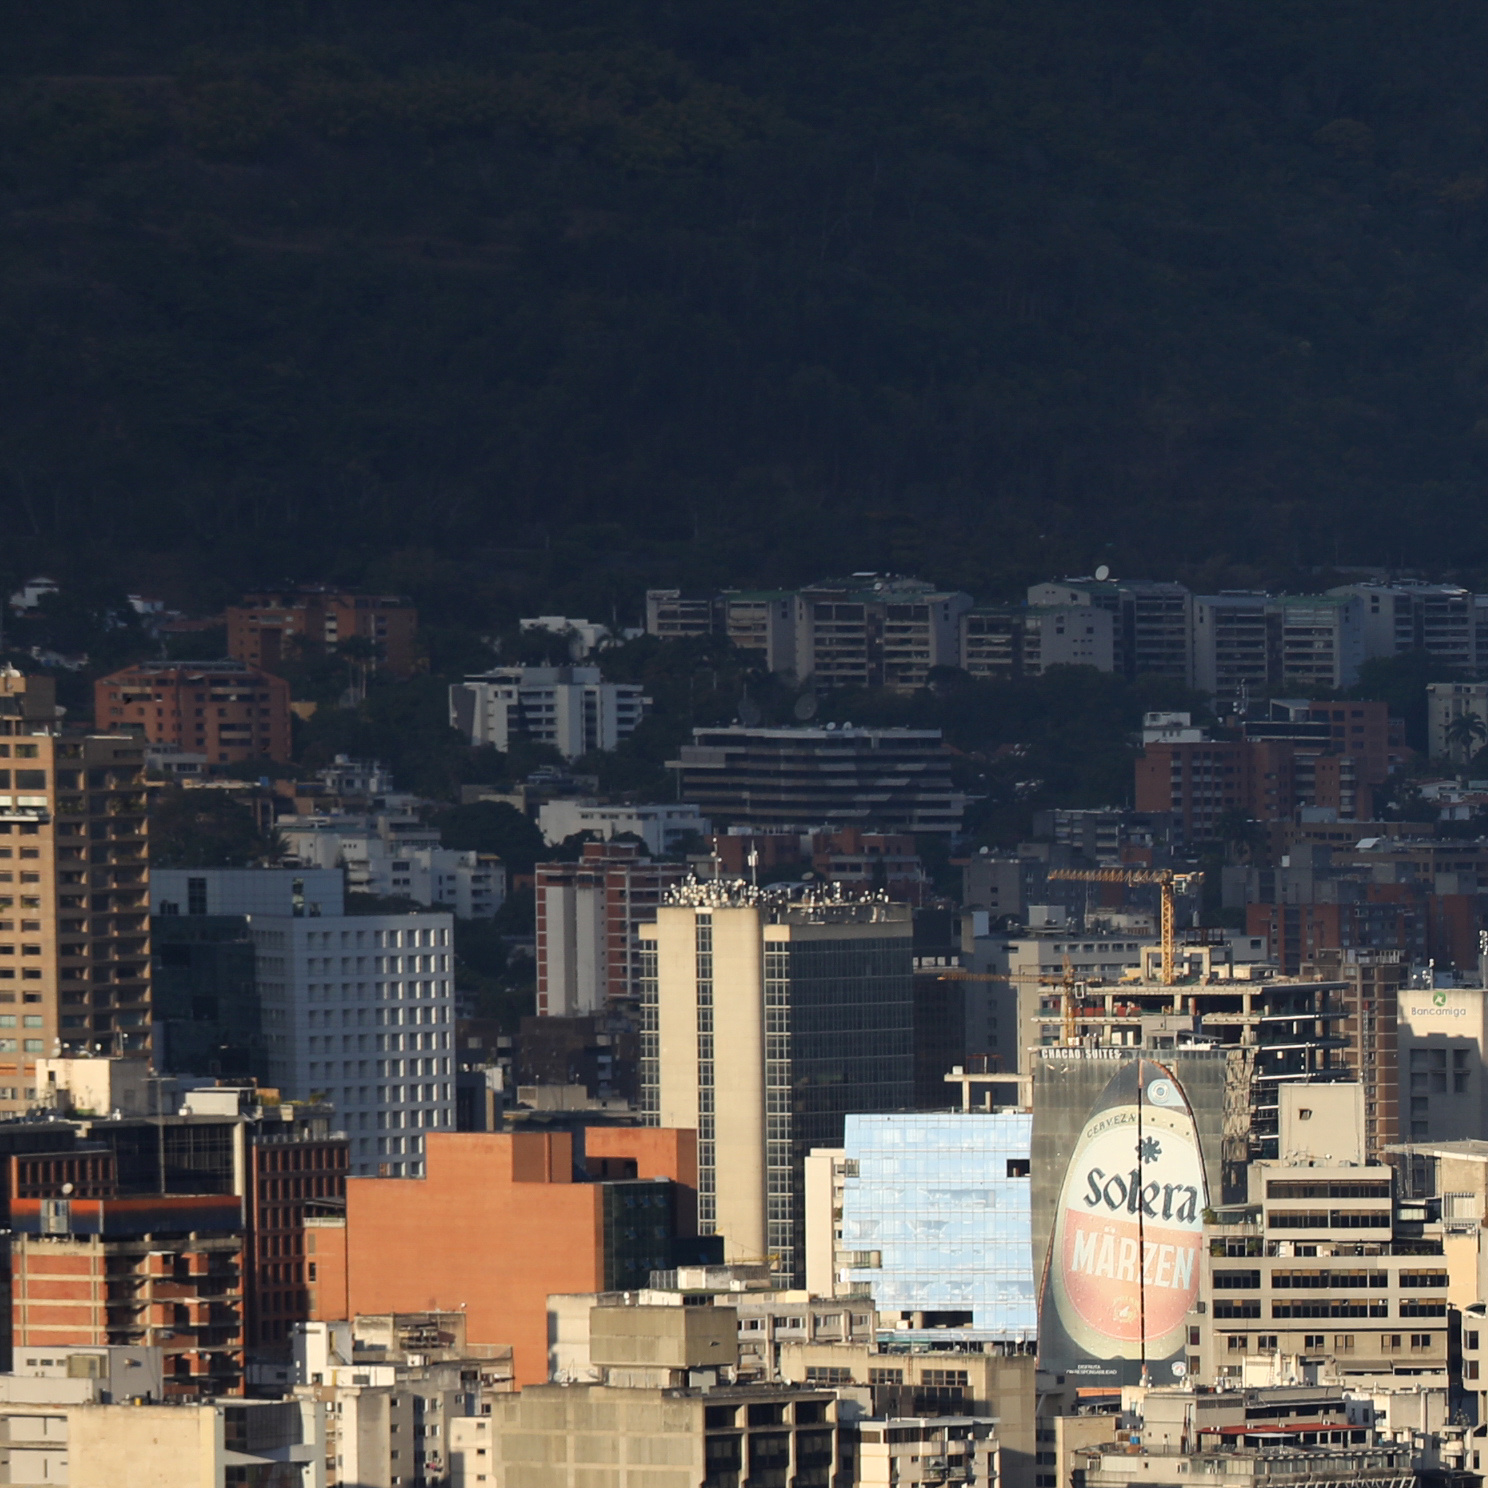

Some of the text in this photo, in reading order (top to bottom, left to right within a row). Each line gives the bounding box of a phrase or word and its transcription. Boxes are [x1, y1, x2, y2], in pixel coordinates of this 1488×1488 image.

[1411, 1007, 1467, 1018] Bancamiga
[1041, 1049, 1122, 1059] CHACAO SUITES
[1086, 1113, 1137, 1139] CERVEZA
[1071, 1226, 1196, 1291] MÄRZEN
